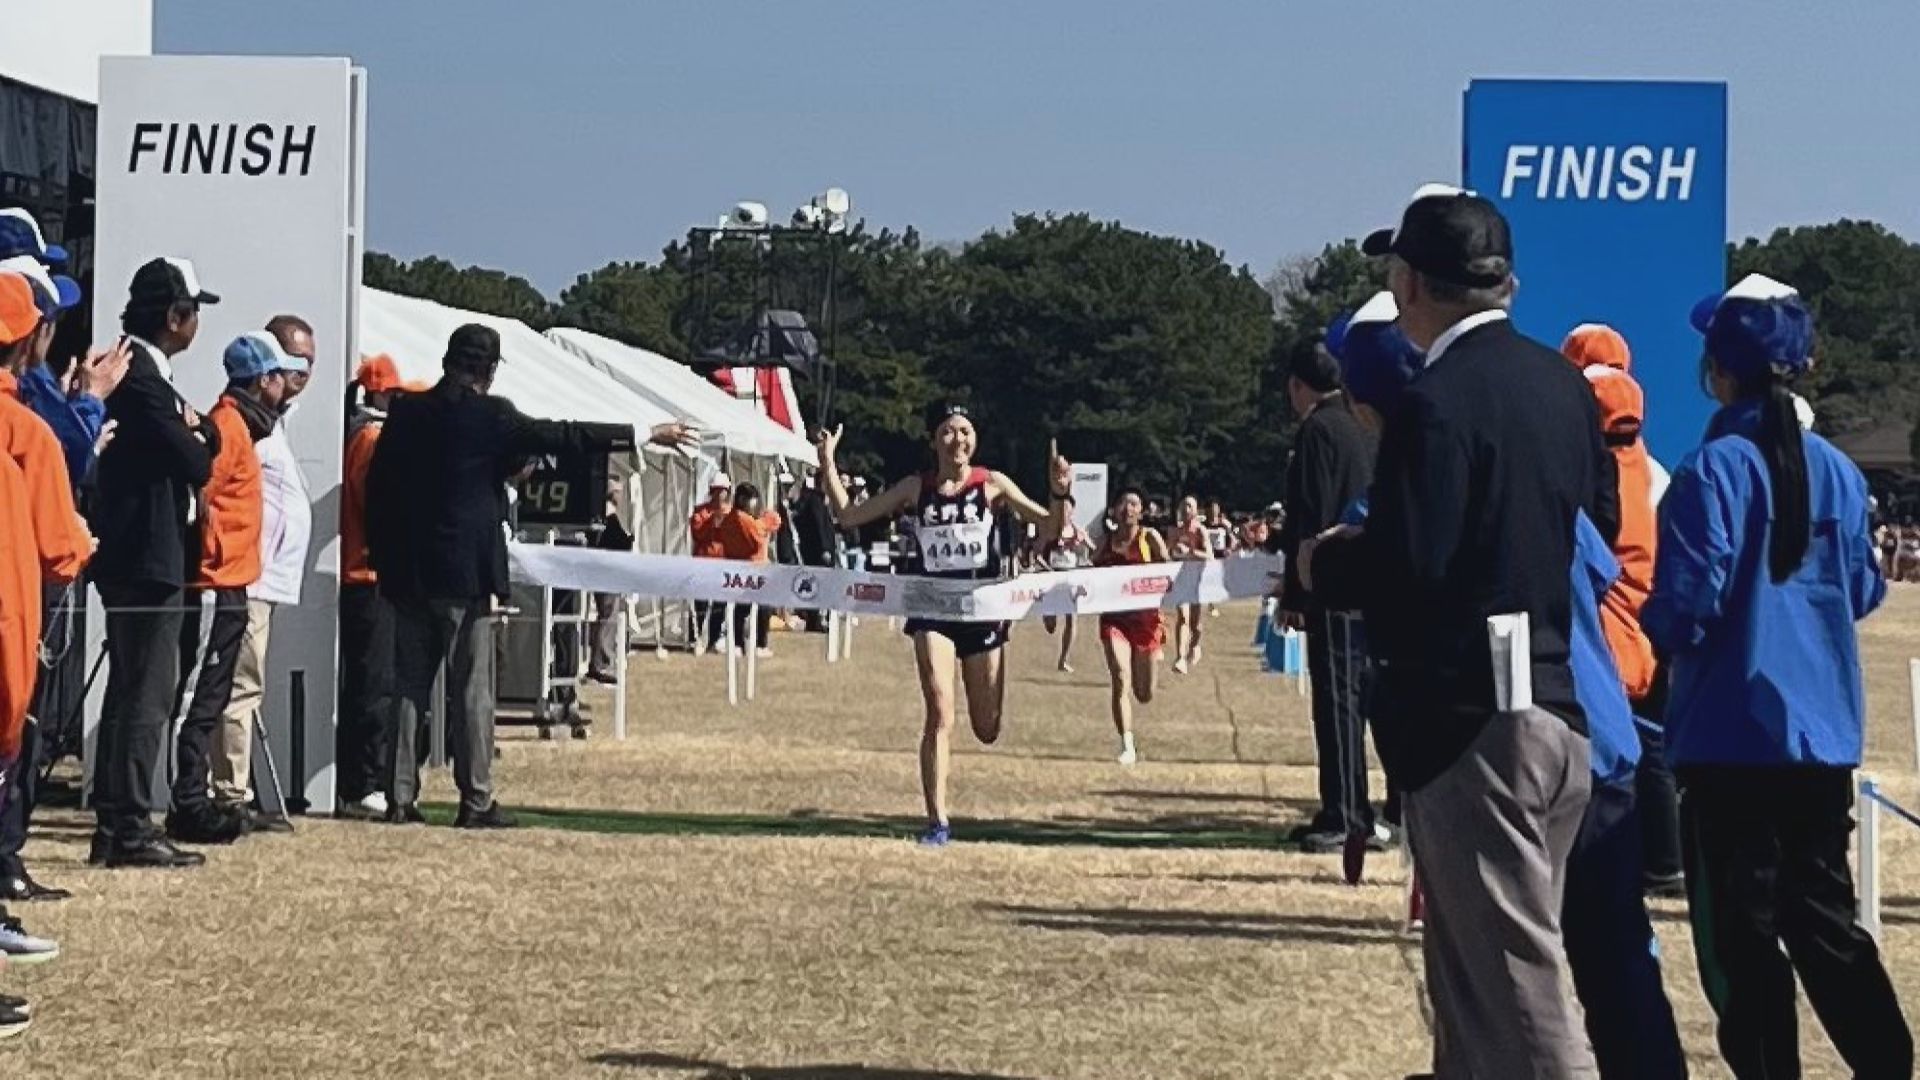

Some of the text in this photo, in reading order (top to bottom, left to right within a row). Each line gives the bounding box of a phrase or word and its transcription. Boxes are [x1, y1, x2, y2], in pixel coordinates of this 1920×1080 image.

[128, 122, 316, 176] FINISH
[1502, 145, 1697, 201] FINISH
[525, 481, 569, 513] 49
[722, 571, 766, 591] JAAF
